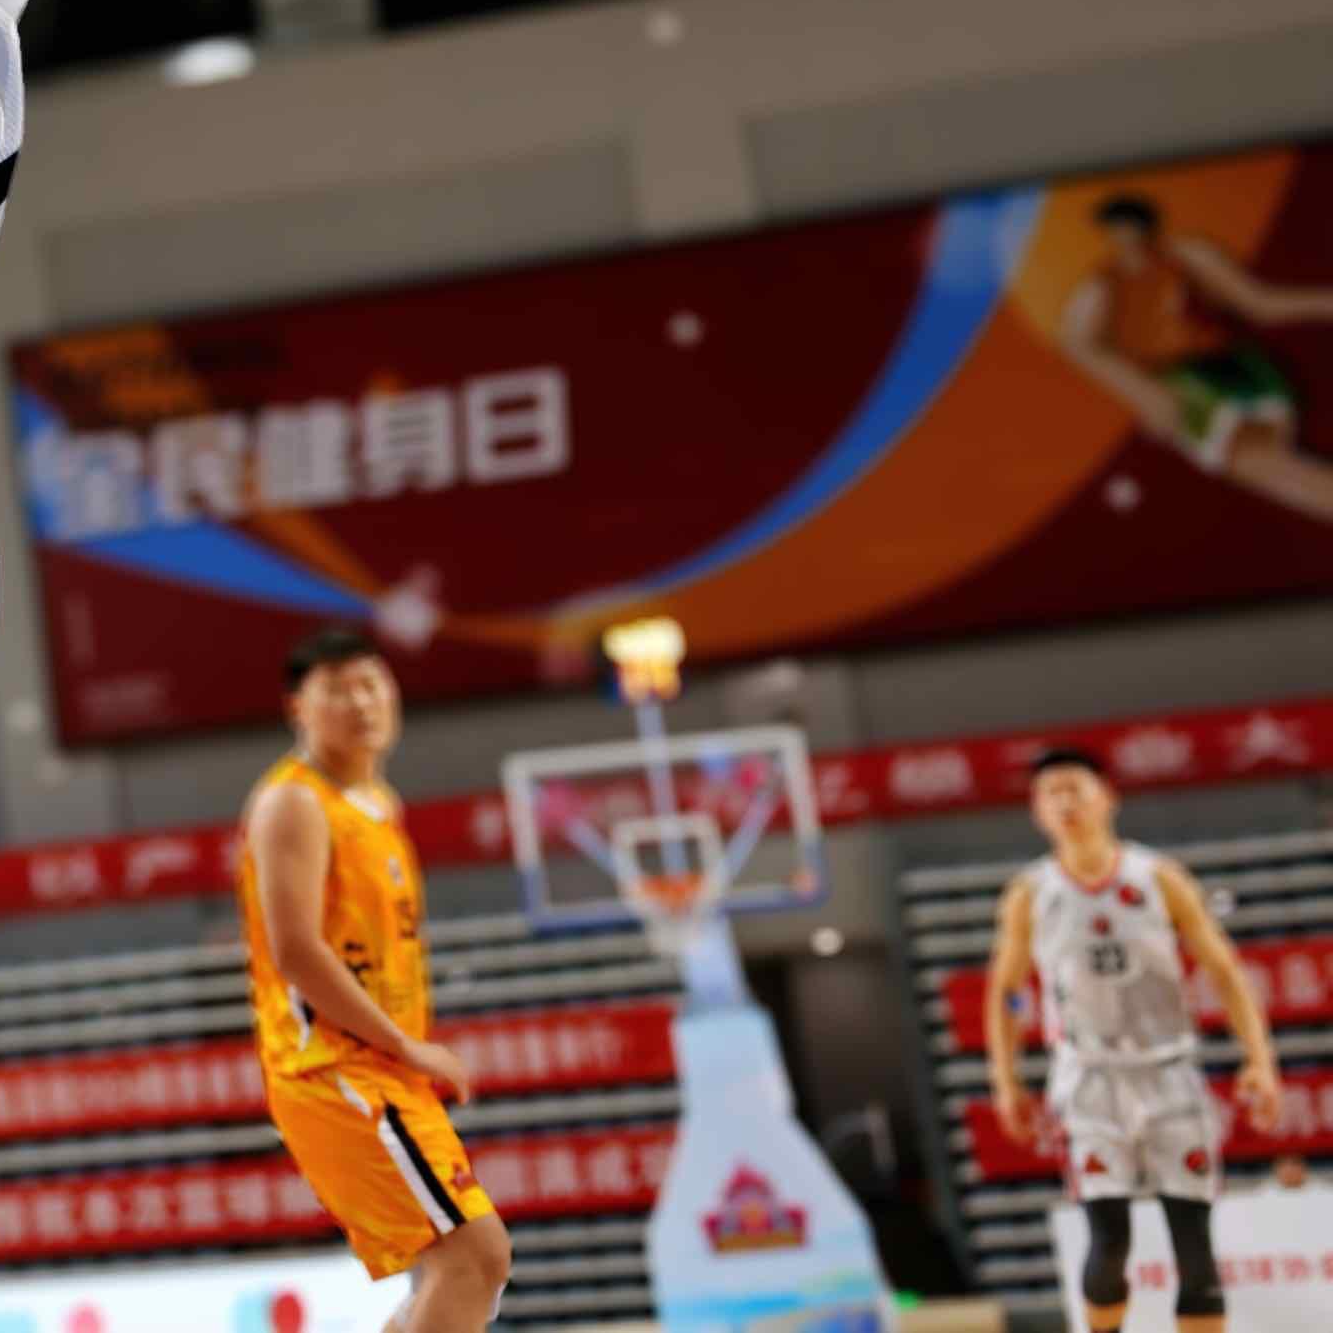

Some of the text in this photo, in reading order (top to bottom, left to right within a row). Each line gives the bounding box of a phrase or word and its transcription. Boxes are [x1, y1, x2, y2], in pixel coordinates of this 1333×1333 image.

[23, 365, 573, 543] 全民健身日
